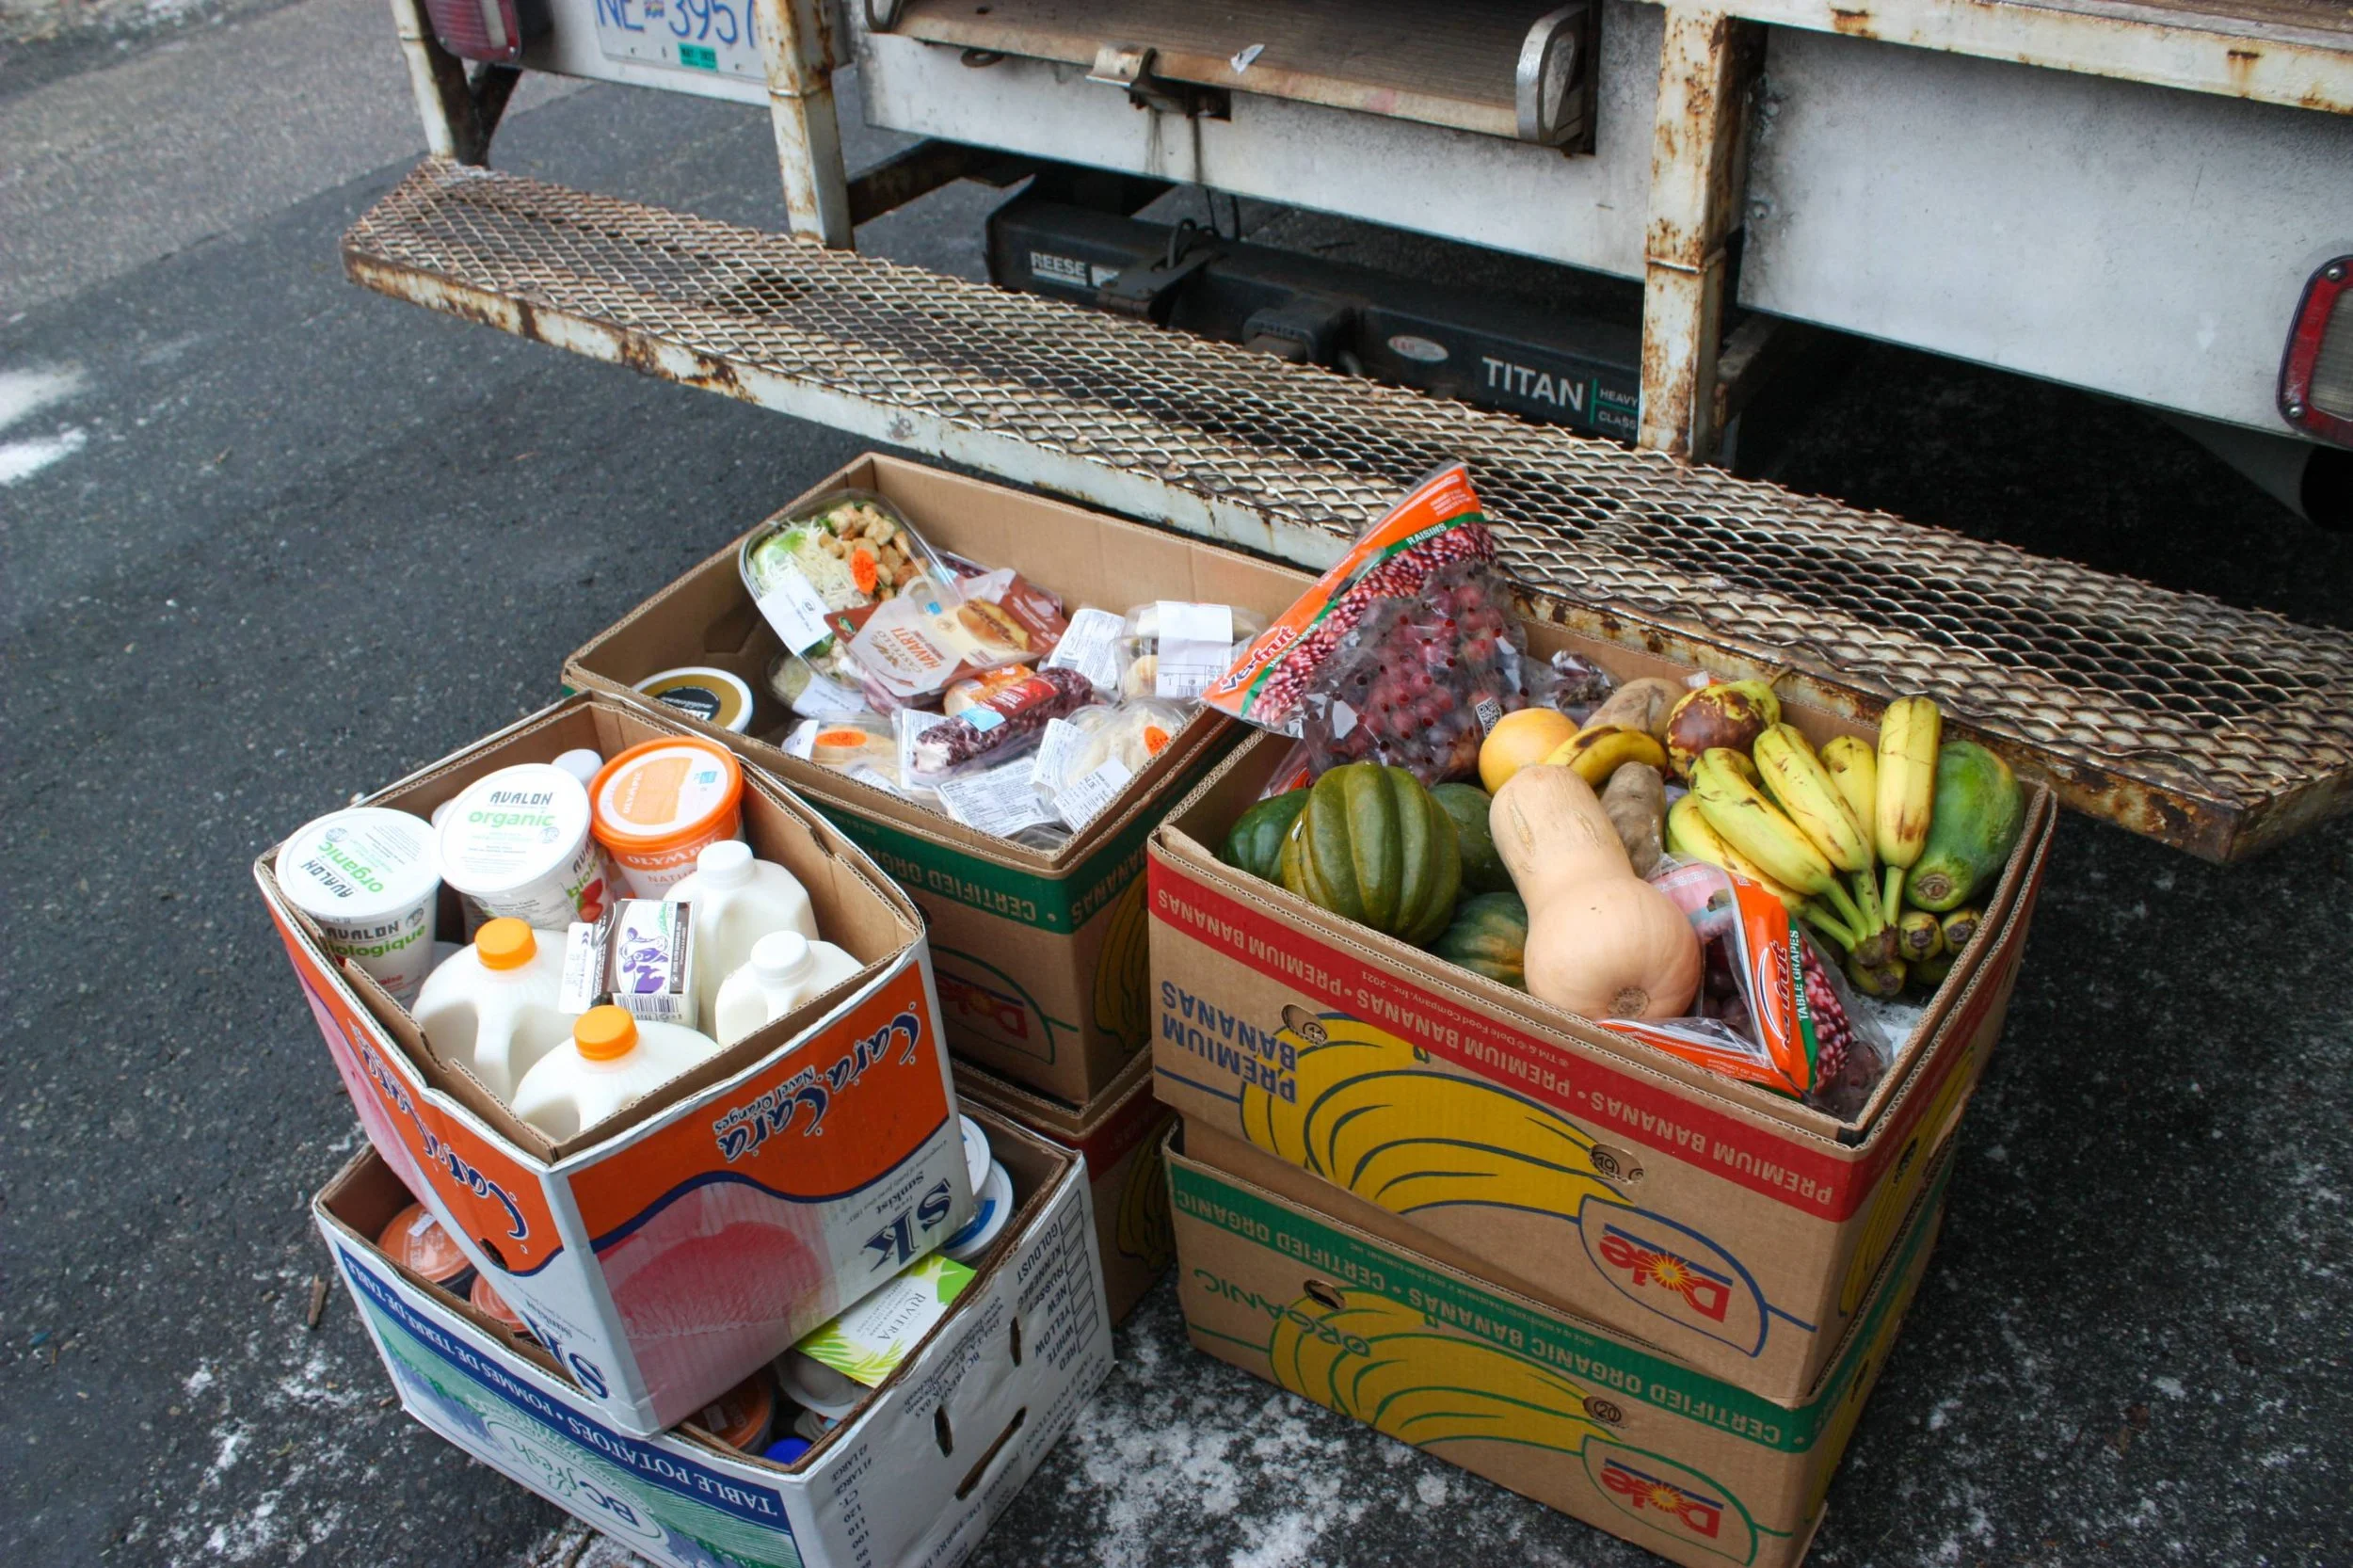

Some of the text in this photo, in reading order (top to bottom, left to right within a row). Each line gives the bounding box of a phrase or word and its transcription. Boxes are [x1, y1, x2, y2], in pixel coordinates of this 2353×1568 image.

[1030, 251, 1086, 277] REESE
[1481, 356, 1585, 411] TITAN
[1600, 388, 1639, 407] HEAVY
[1598, 411, 1638, 430] CLASS
[1406, 522, 1447, 547] RAISINS
[890, 627, 942, 670] HAVARTI
[468, 810, 556, 828] organic
[490, 791, 553, 807] AVALON
[299, 859, 356, 899] AVALON
[318, 840, 384, 893] organic
[927, 871, 1037, 922] CERTIFIED
[326, 920, 400, 940] AVALON
[1359, 969, 1387, 988] 2021
[1789, 929, 1809, 1021] TABLE GRAPES
[1158, 888, 1833, 1206] PREMIUM BANANAS PREMIUM BANANAS PREMIUM BANANAS
[1160, 980, 1297, 1073] BANANAS
[1456, 1014, 1490, 1034] Food
[1488, 1028, 1515, 1045] Dole
[1161, 1013, 1297, 1105] PREMIUM
[713, 1064, 816, 1134] Navel Oranges
[716, 1010, 920, 1162] Cara Cara
[436, 1133, 529, 1240] Cara
[874, 1170, 926, 1216] Sunkist
[1176, 1190, 1271, 1243] ORGANIC
[1016, 1223, 1059, 1286] GOLDUST
[1275, 1231, 1385, 1291] CERTIFIED
[1026, 1265, 1065, 1314] RUSSET
[1047, 1287, 1067, 1317] NEW
[1598, 1235, 1732, 1323] Dole
[408, 1311, 456, 1355] TERRE
[876, 1291, 925, 1343] RIVIERA
[1034, 1307, 1071, 1358] YELLOW
[1193, 1267, 1371, 1358] ORGANIC
[1407, 1289, 1526, 1352] BANANAS
[457, 1346, 483, 1368] DE
[1047, 1326, 1074, 1365] WHITE
[1059, 1345, 1079, 1372] RED
[1530, 1333, 1643, 1395] ORGANIC
[482, 1362, 553, 1416] POMMES
[1649, 1383, 1782, 1445] CERTIFIED
[507, 1437, 579, 1492] fresh
[567, 1416, 690, 1485] POTATOES
[828, 1451, 859, 1483] LARGE
[579, 1480, 641, 1528] BC
[692, 1470, 778, 1517] TABLE
[832, 1464, 865, 1497] LARGE
[838, 1487, 859, 1510] CT.
[1600, 1466, 1721, 1540] Dole
[841, 1500, 863, 1525] 120
[845, 1513, 867, 1538] 110
[850, 1528, 871, 1550] 100
[854, 1545, 870, 1562] 90
